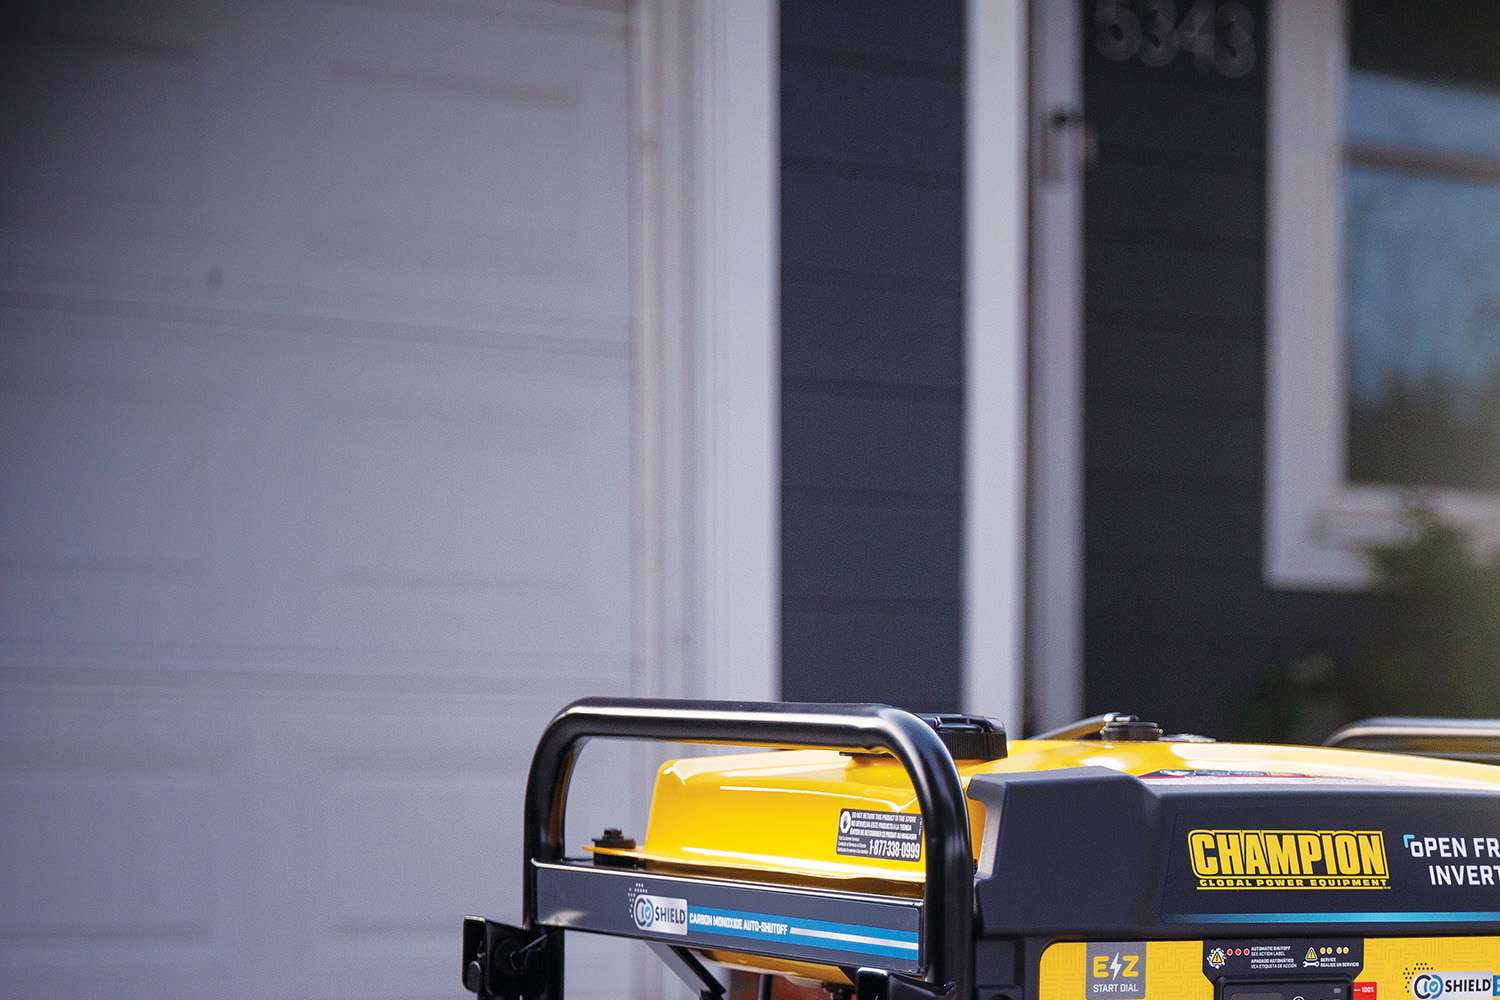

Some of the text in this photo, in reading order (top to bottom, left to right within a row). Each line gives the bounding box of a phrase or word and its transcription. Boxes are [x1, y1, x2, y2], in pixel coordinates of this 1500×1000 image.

[1094, 0, 1257, 78] 5343
[869, 839, 920, 860] 1-877-338-0999
[1190, 831, 1388, 877] CHAMPION
[1410, 837, 1467, 858] OPEN
[1200, 879, 1387, 888] GLOBAL POWER EQUIPMENT
[654, 906, 686, 925] SHIELD
[689, 912, 788, 936] CARBON MONOXIDE AUTO-SHUTOFF
[1093, 984, 1139, 992] START DIAL
[1444, 979, 1491, 993] SHIELD
